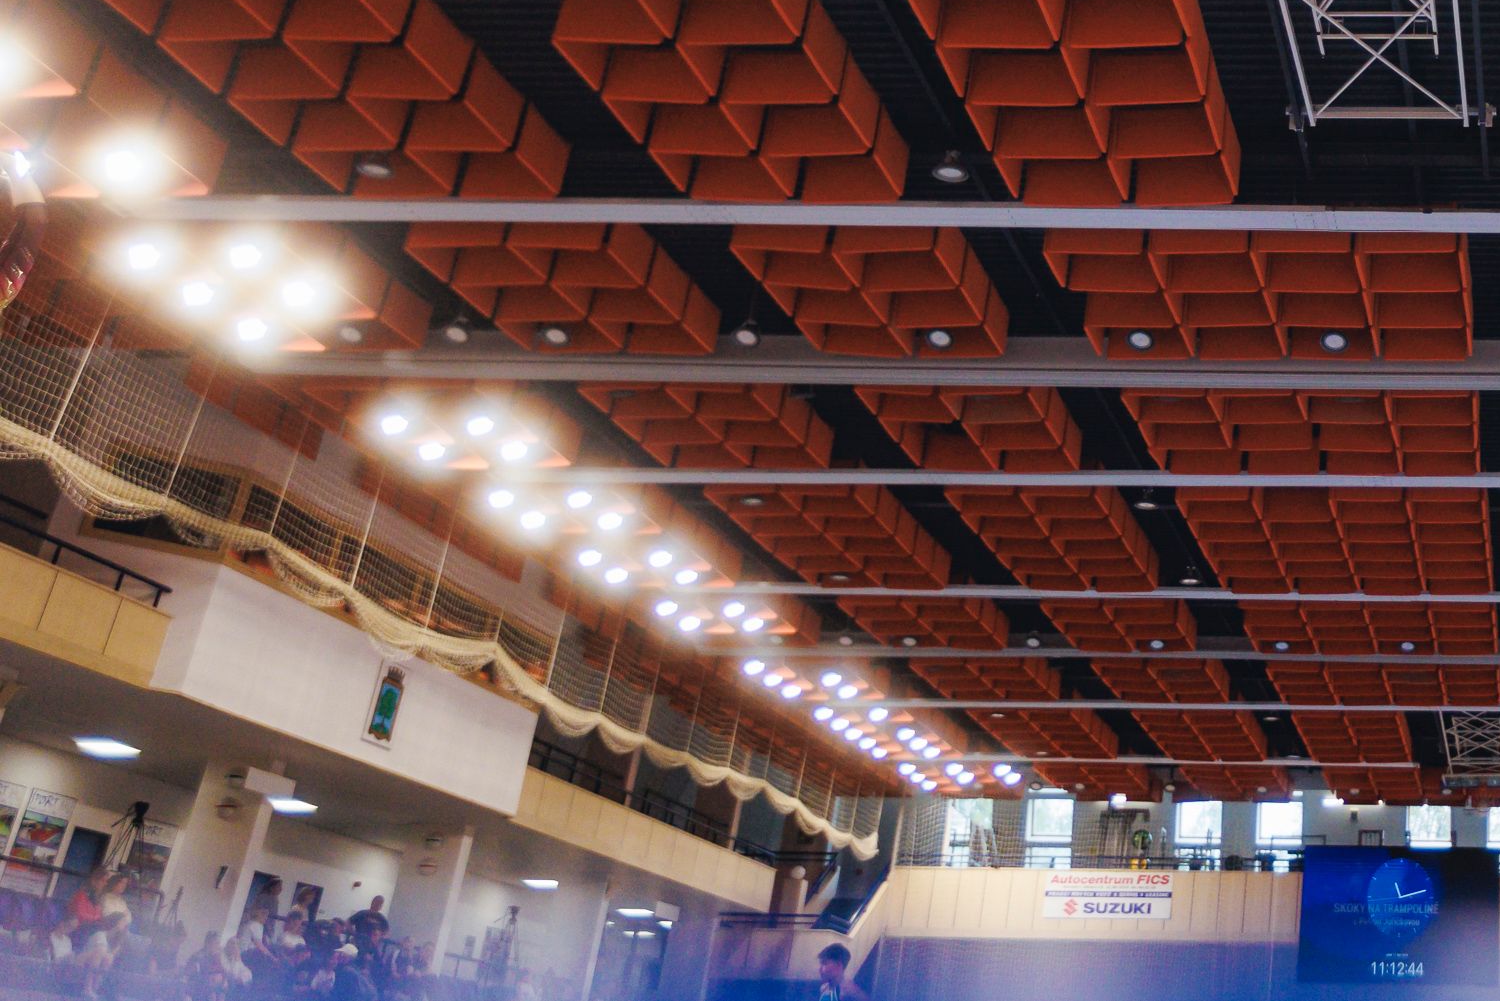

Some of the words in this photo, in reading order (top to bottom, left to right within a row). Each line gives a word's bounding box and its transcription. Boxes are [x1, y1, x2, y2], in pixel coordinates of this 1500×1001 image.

[1051, 875, 1133, 885] Autocentrum
[1137, 875, 1170, 885] FICS
[1083, 902, 1152, 914] SUZUKI
[1368, 904, 1381, 913] NA
[1371, 961, 1424, 976] 11:12:44
